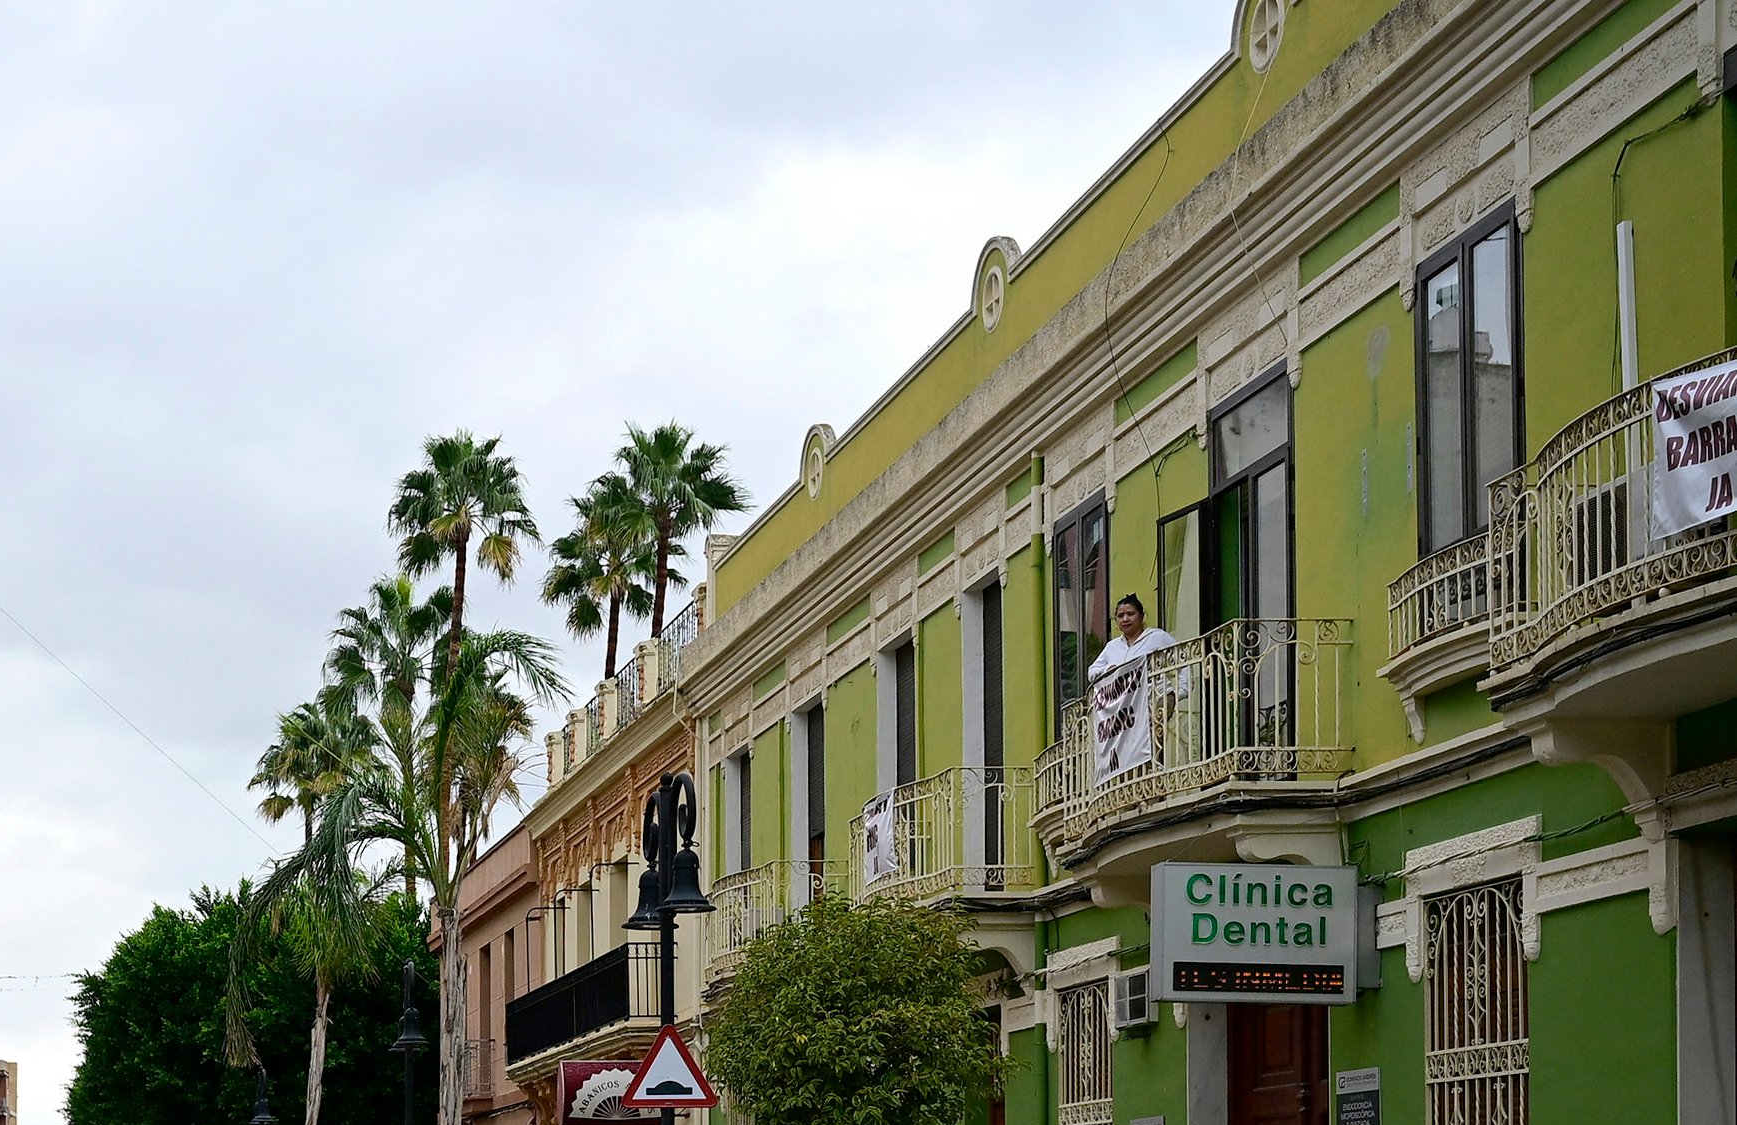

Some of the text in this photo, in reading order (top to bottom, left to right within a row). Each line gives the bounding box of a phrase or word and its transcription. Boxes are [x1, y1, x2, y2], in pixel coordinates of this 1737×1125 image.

[1656, 369, 1737, 424] DESVIA
[1705, 472, 1733, 513] JA
[1186, 873, 1333, 906] Clínica
[1192, 913, 1326, 945] Dental
[578, 1080, 620, 1114] ABANICOS
